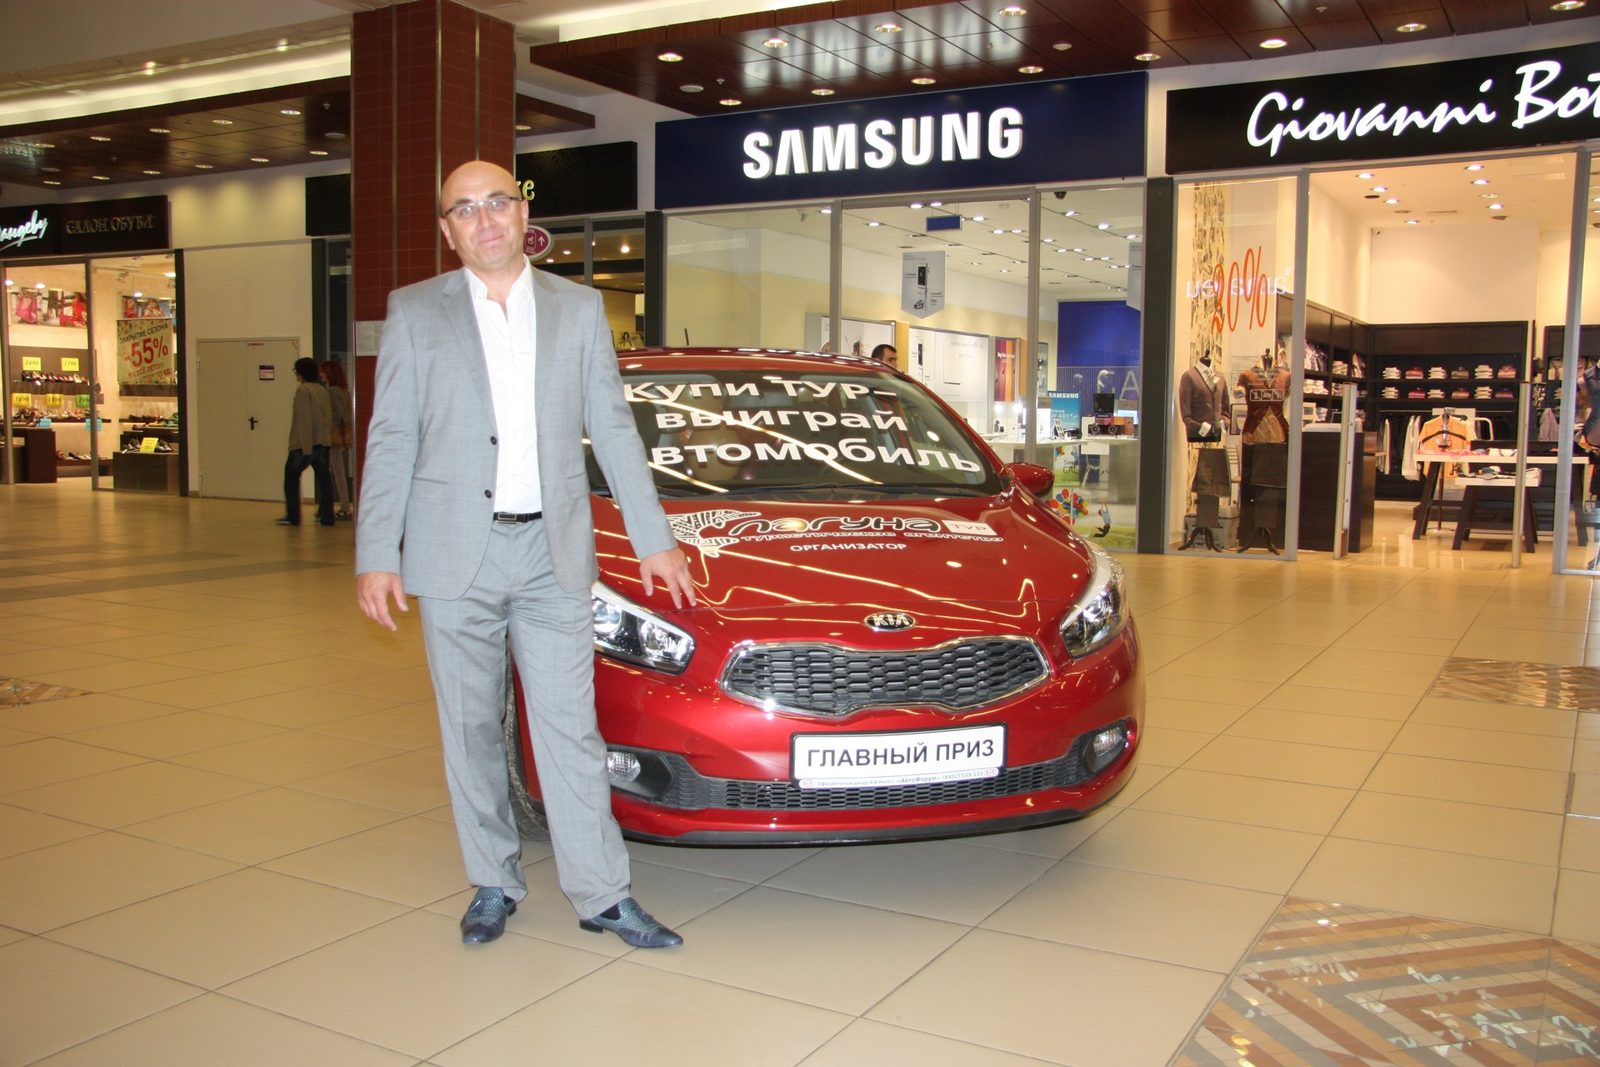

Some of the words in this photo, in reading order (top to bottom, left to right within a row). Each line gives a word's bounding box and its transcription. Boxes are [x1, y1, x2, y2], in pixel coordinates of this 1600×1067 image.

[1247, 79, 1496, 158] Giovanni
[743, 107, 1024, 179] SAMSUNG
[1210, 246, 1268, 333] 20%
[656, 410, 907, 431] выиграй
[651, 438, 981, 473] втомобиль
[790, 543, 907, 552] ОРГАНИЗАТОР
[808, 742, 927, 767] ГЛАВНЫЙ
[936, 739, 994, 761] ПРИЗ
